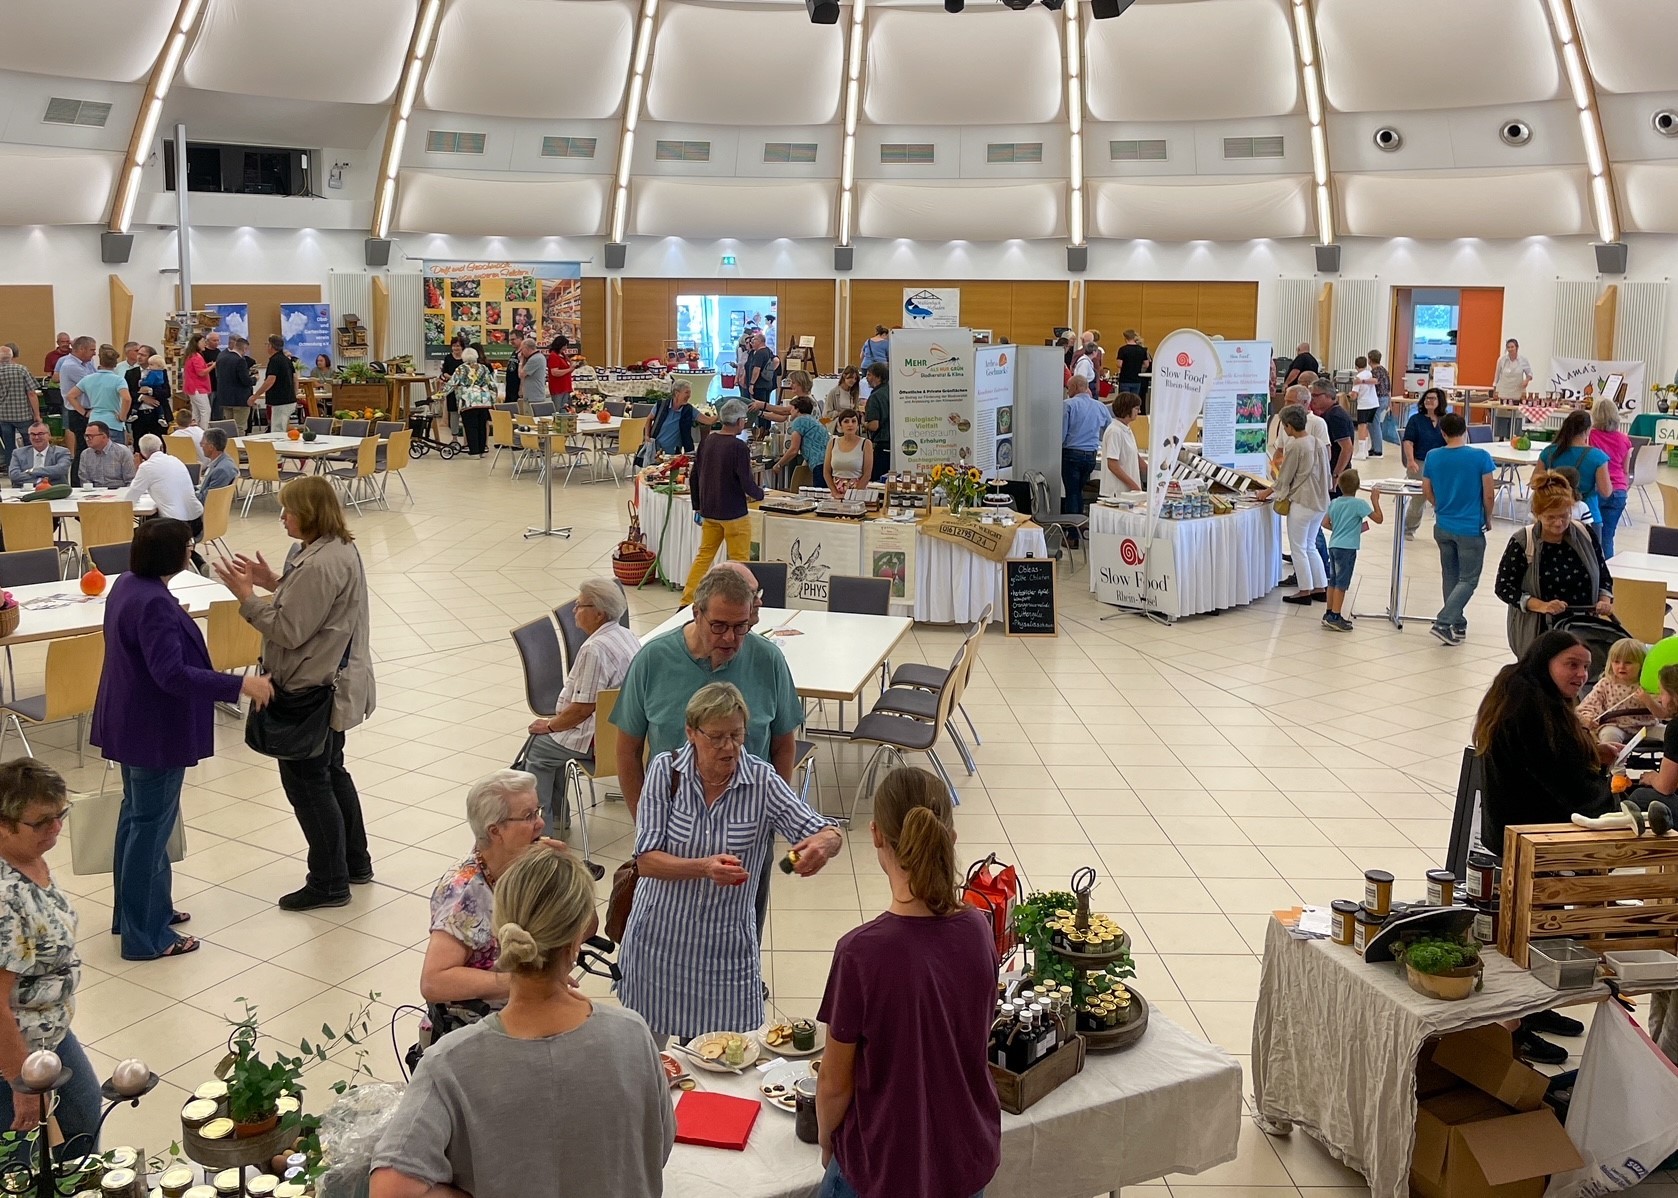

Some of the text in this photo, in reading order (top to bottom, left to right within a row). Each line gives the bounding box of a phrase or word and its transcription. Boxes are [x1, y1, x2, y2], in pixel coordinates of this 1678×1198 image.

[904, 358, 927, 367] MEHR
[1160, 366, 1180, 378] Slow
[1551, 363, 1597, 392] Mama's
[1165, 379, 1201, 392] Rhein-Mosel
[903, 429, 957, 438] Lebensraum
[920, 448, 957, 457] Nahrung
[1100, 566, 1130, 586] Slow
[804, 582, 827, 598] PHYS
